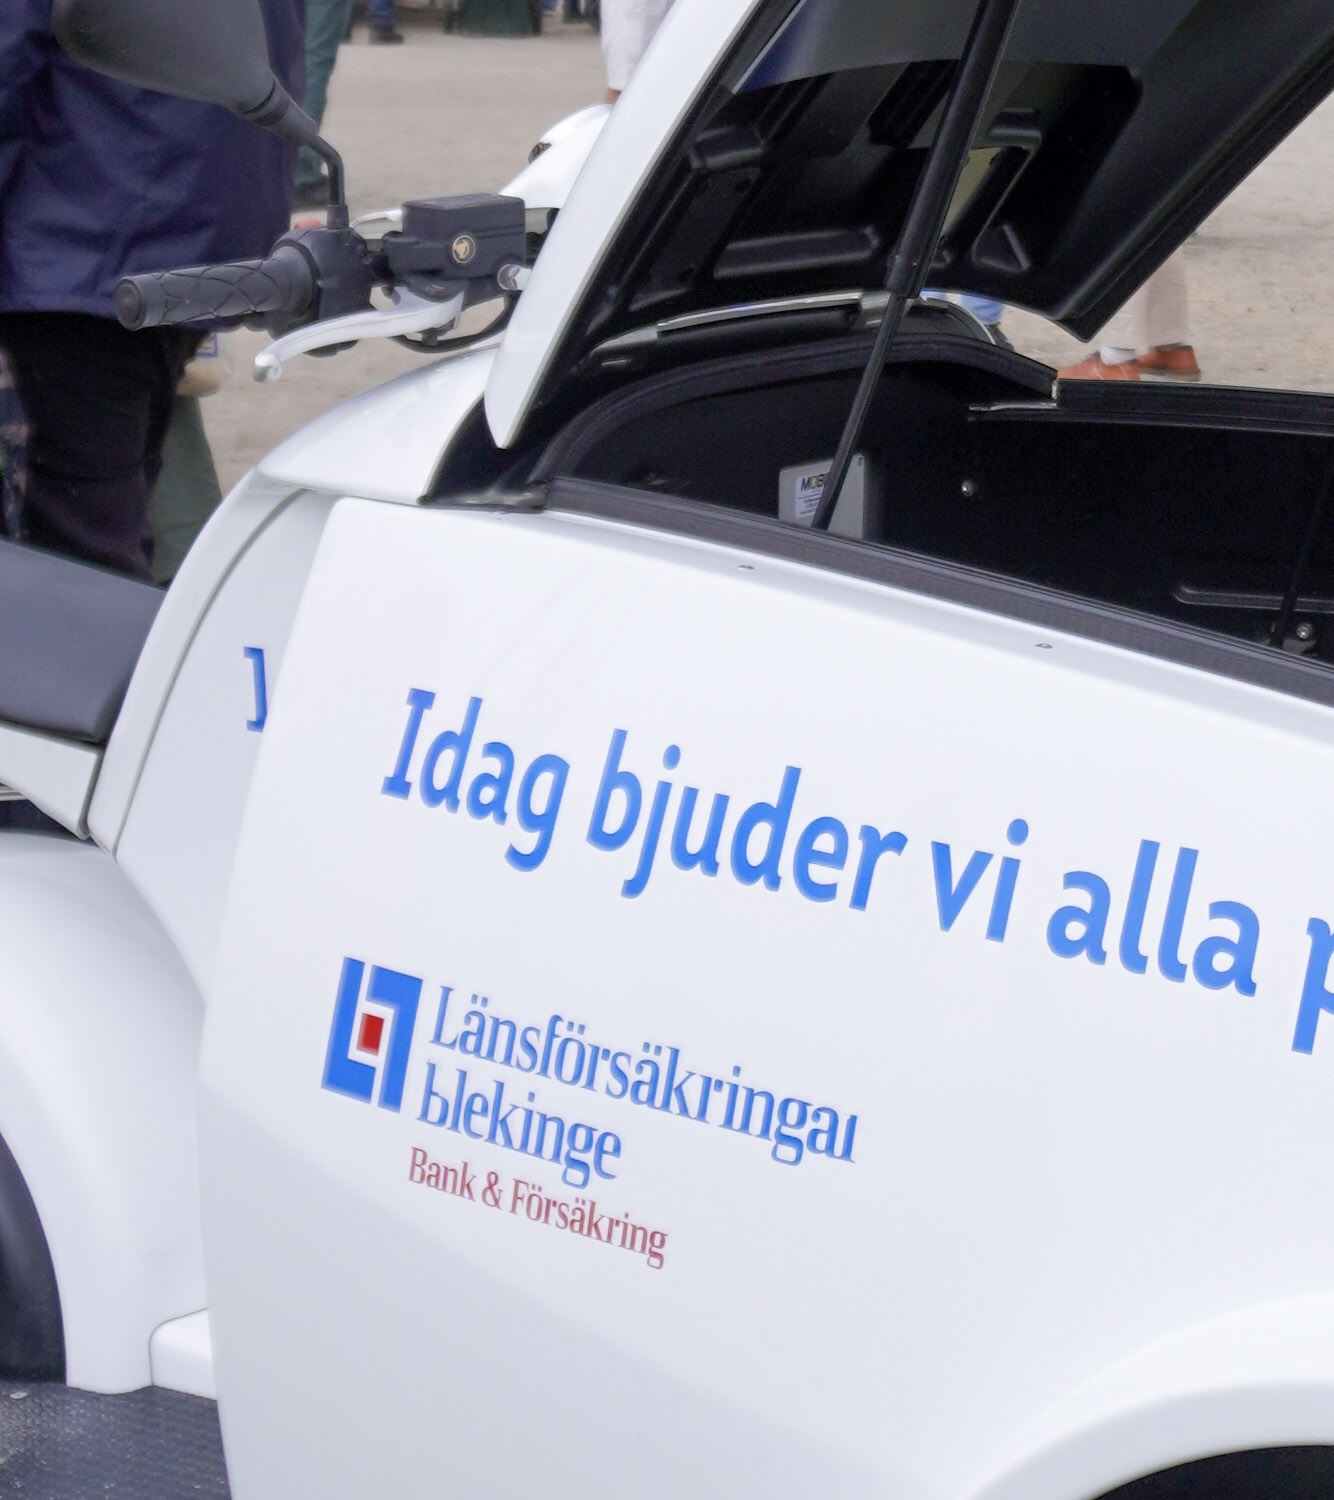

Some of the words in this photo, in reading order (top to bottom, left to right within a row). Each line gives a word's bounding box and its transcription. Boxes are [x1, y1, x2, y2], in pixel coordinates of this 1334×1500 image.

[380, 686, 572, 873] Idag
[584, 728, 910, 912] bjuder
[928, 817, 1030, 943] vi
[1045, 838, 1261, 998] alla
[407, 1145, 477, 1203] Bank
[480, 1169, 504, 1212] &
[508, 1176, 669, 1271] Försäkring
